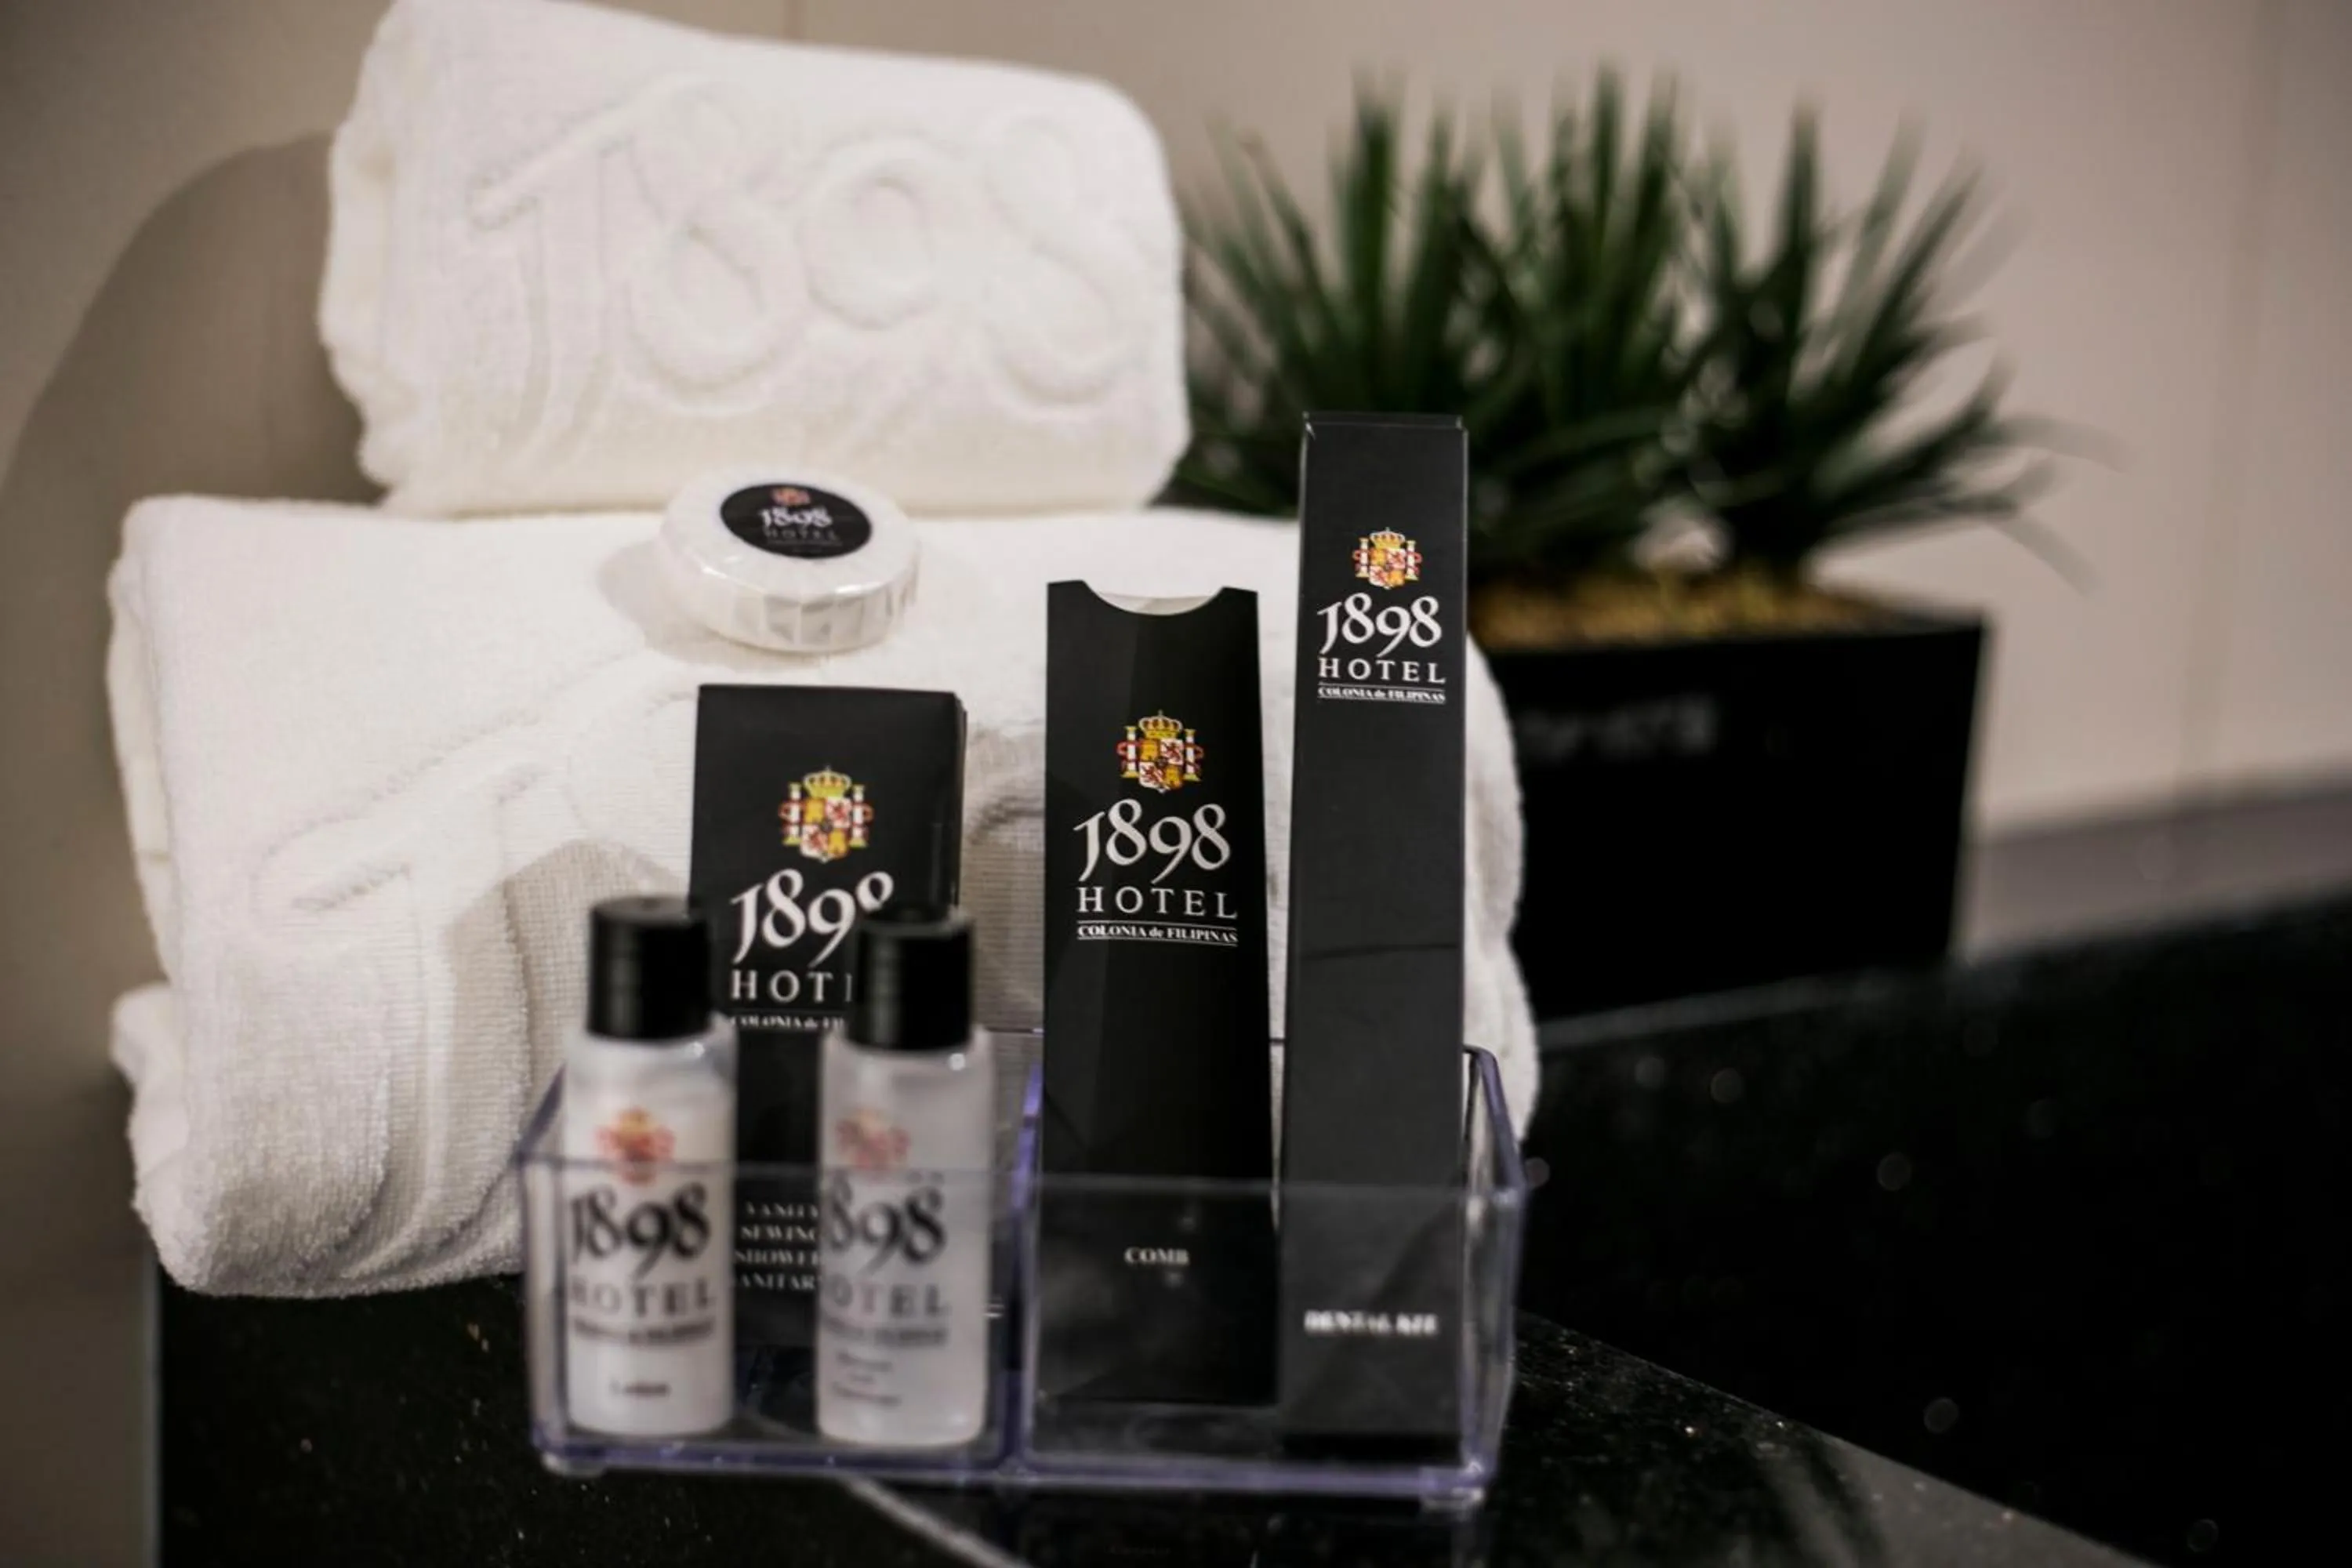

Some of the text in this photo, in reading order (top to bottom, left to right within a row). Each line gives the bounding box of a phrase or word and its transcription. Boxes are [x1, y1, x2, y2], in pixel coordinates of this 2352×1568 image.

[759, 506, 833, 528] 1898
[1316, 592, 1443, 658] 1898
[1318, 658, 1446, 684] HOTEL
[1317, 687, 1374, 699] COLONIA
[1073, 798, 1231, 884] 1898
[1077, 886, 1238, 919] HOTEL
[1077, 924, 1239, 942] COLONIA de FILIPINAS
[731, 969, 853, 1004] HOT
[570, 1182, 712, 1281] 1898
[822, 1170, 948, 1275] 898
[1123, 1247, 1190, 1266] COMB
